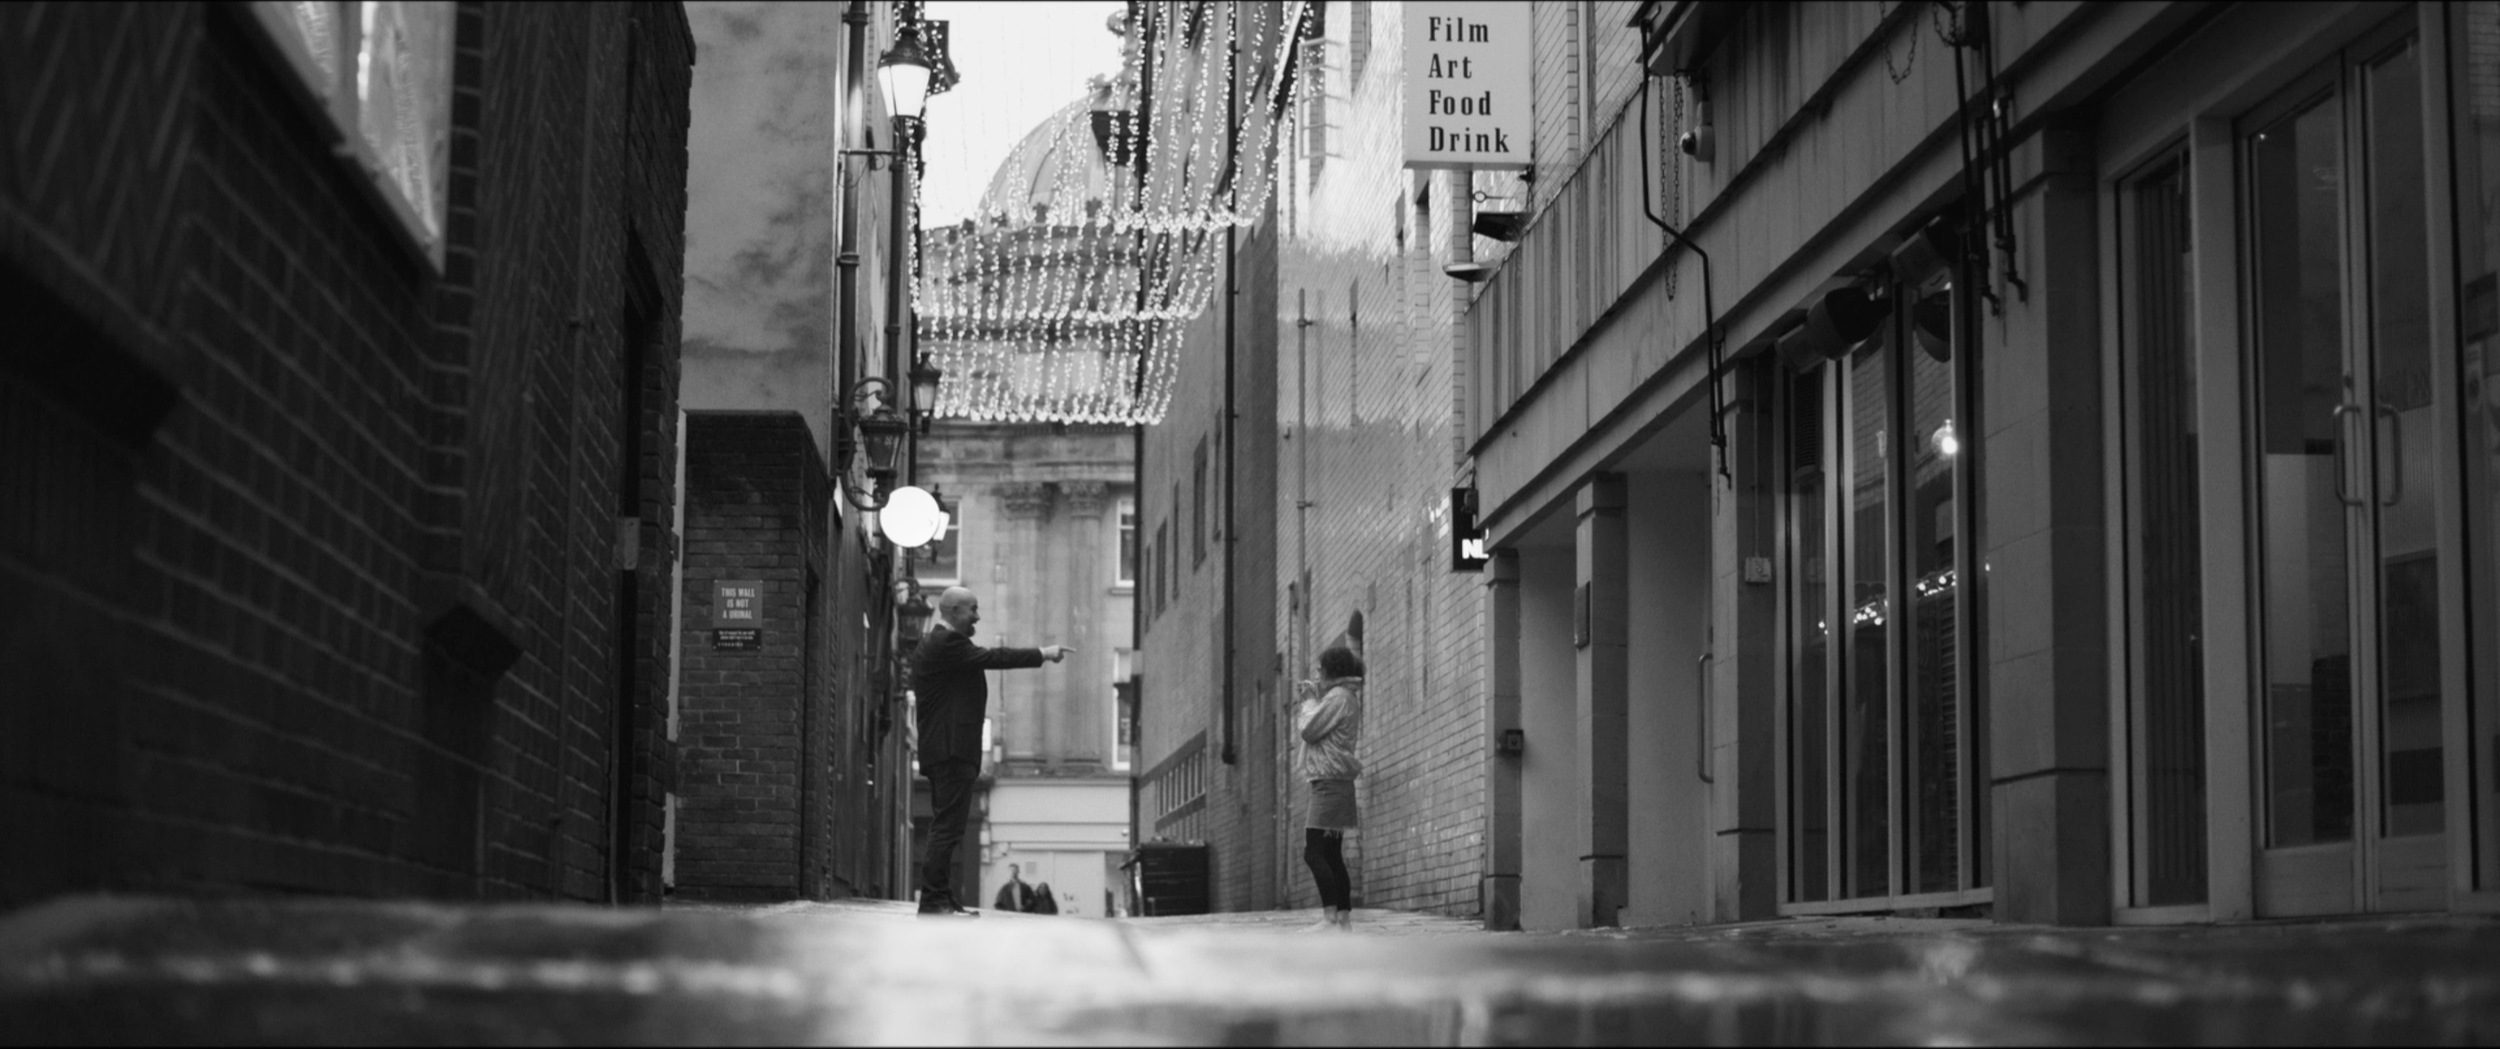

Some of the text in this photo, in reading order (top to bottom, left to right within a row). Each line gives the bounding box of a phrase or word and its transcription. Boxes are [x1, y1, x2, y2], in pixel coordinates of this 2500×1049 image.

[1429, 16, 1489, 43] Film
[1428, 53, 1472, 79] Art
[1429, 89, 1491, 116] Food
[1429, 126, 1510, 153] Drink
[721, 588, 755, 597] THIS WALL
[727, 599, 749, 608] IS NOT
[722, 610, 753, 619] A URINAL
